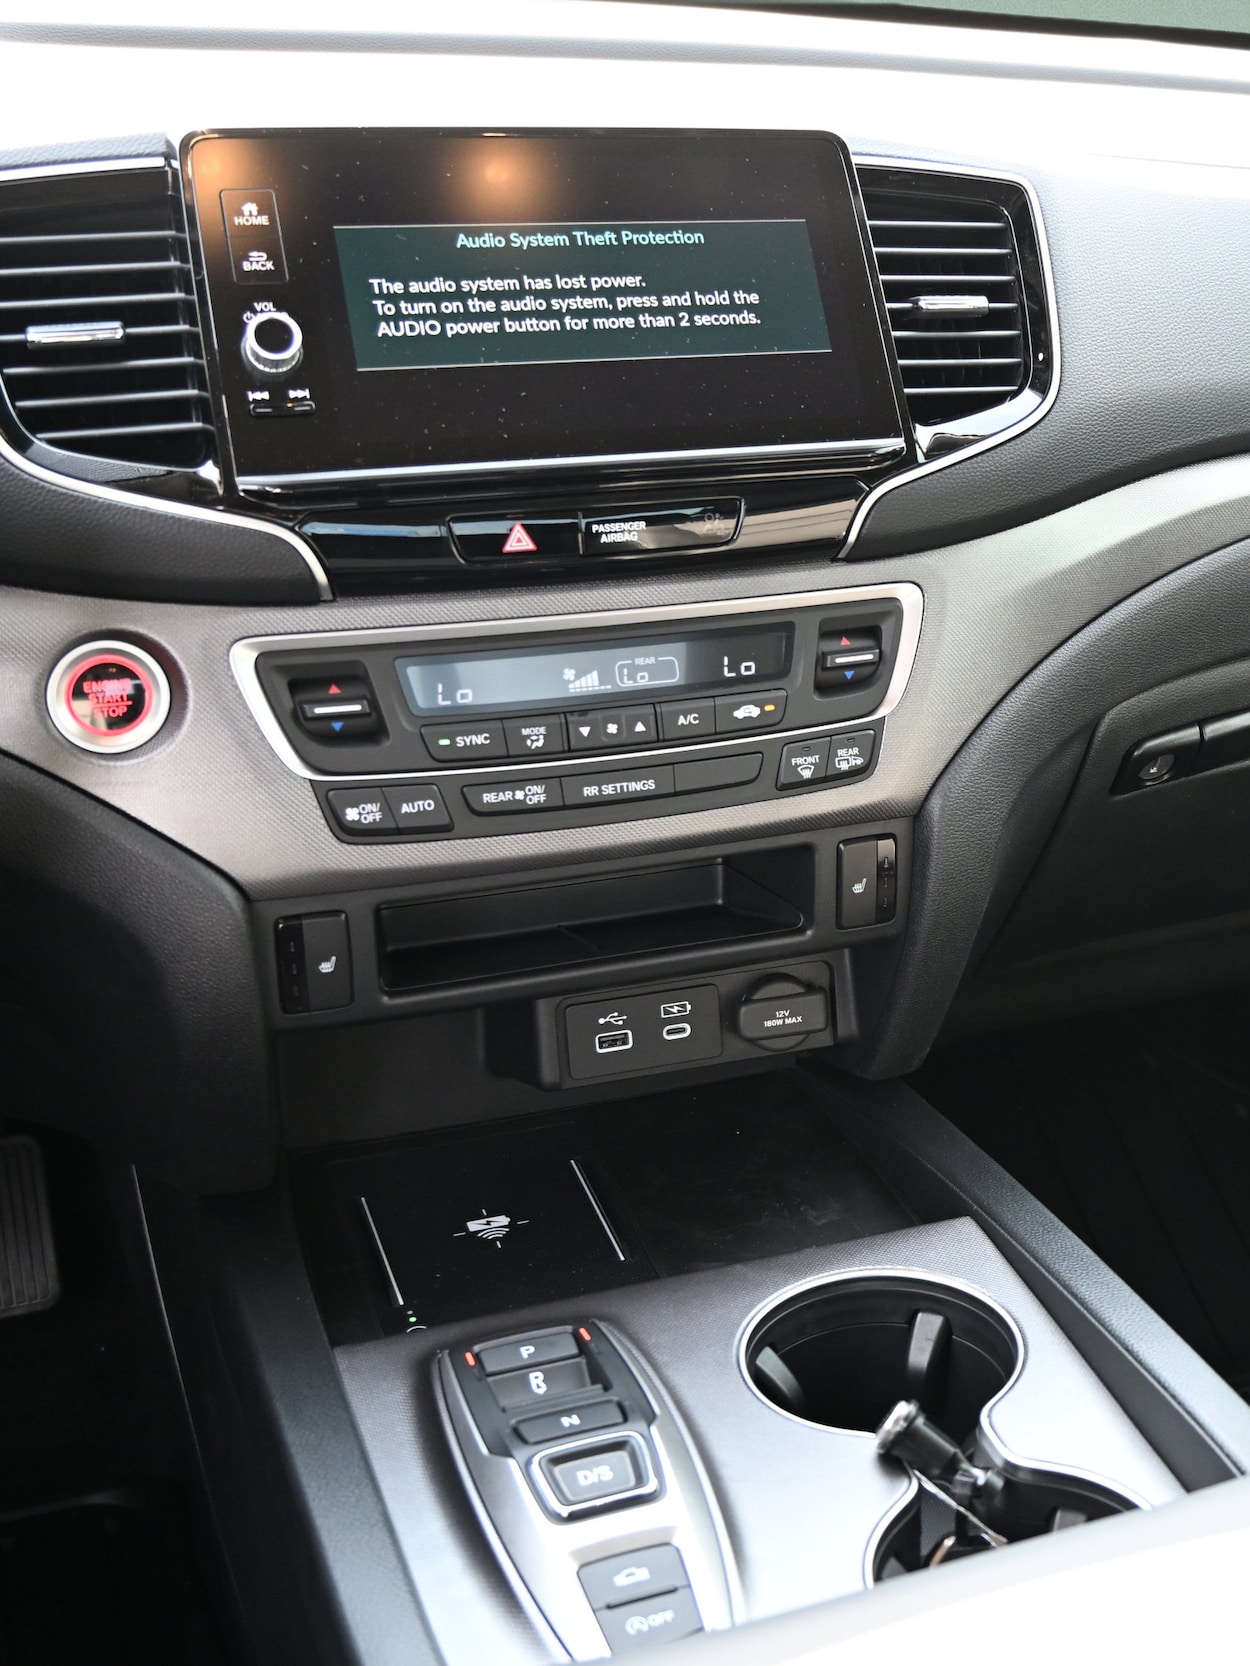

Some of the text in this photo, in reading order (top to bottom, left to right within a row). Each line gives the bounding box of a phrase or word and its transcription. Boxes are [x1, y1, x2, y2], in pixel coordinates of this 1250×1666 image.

[234, 216, 270, 226] HOME
[456, 230, 705, 250] Audio System Theft Protection
[242, 261, 274, 272] BACK
[368, 274, 646, 294] The audio system has lost power.
[253, 302, 276, 312] VOL
[372, 290, 760, 315] To turn on the audio system, press and hold the
[377, 310, 761, 338] AUDIO power button for more than 2 seconds.
[592, 521, 646, 534] PASSENGER
[600, 531, 638, 543] AIRBAG
[634, 657, 656, 666] REAR
[724, 656, 756, 677] Lo
[623, 668, 649, 684] Lo
[83, 678, 131, 692] ENGINE
[88, 692, 129, 704] START
[438, 683, 474, 706] Lo
[94, 706, 128, 718] STOP
[678, 713, 700, 726] A/C
[522, 726, 546, 736] MODE
[456, 734, 490, 748] SYNC
[837, 747, 860, 757] REAR
[792, 754, 820, 766] FRONT
[482, 784, 546, 804] REAR ON/
[583, 780, 656, 797] RR SETTINGS
[526, 794, 546, 805] OFF
[360, 802, 380, 812] ON/
[400, 800, 435, 814] AUTO
[362, 812, 382, 824] OFF
[775, 1010, 790, 1018] 12V
[764, 1015, 802, 1027] 180W MAX
[520, 1345, 536, 1359] P
[529, 1372, 543, 1389] R
[560, 1414, 581, 1427] N
[576, 1464, 614, 1486] D/S
[646, 1610, 676, 1626] OFF
